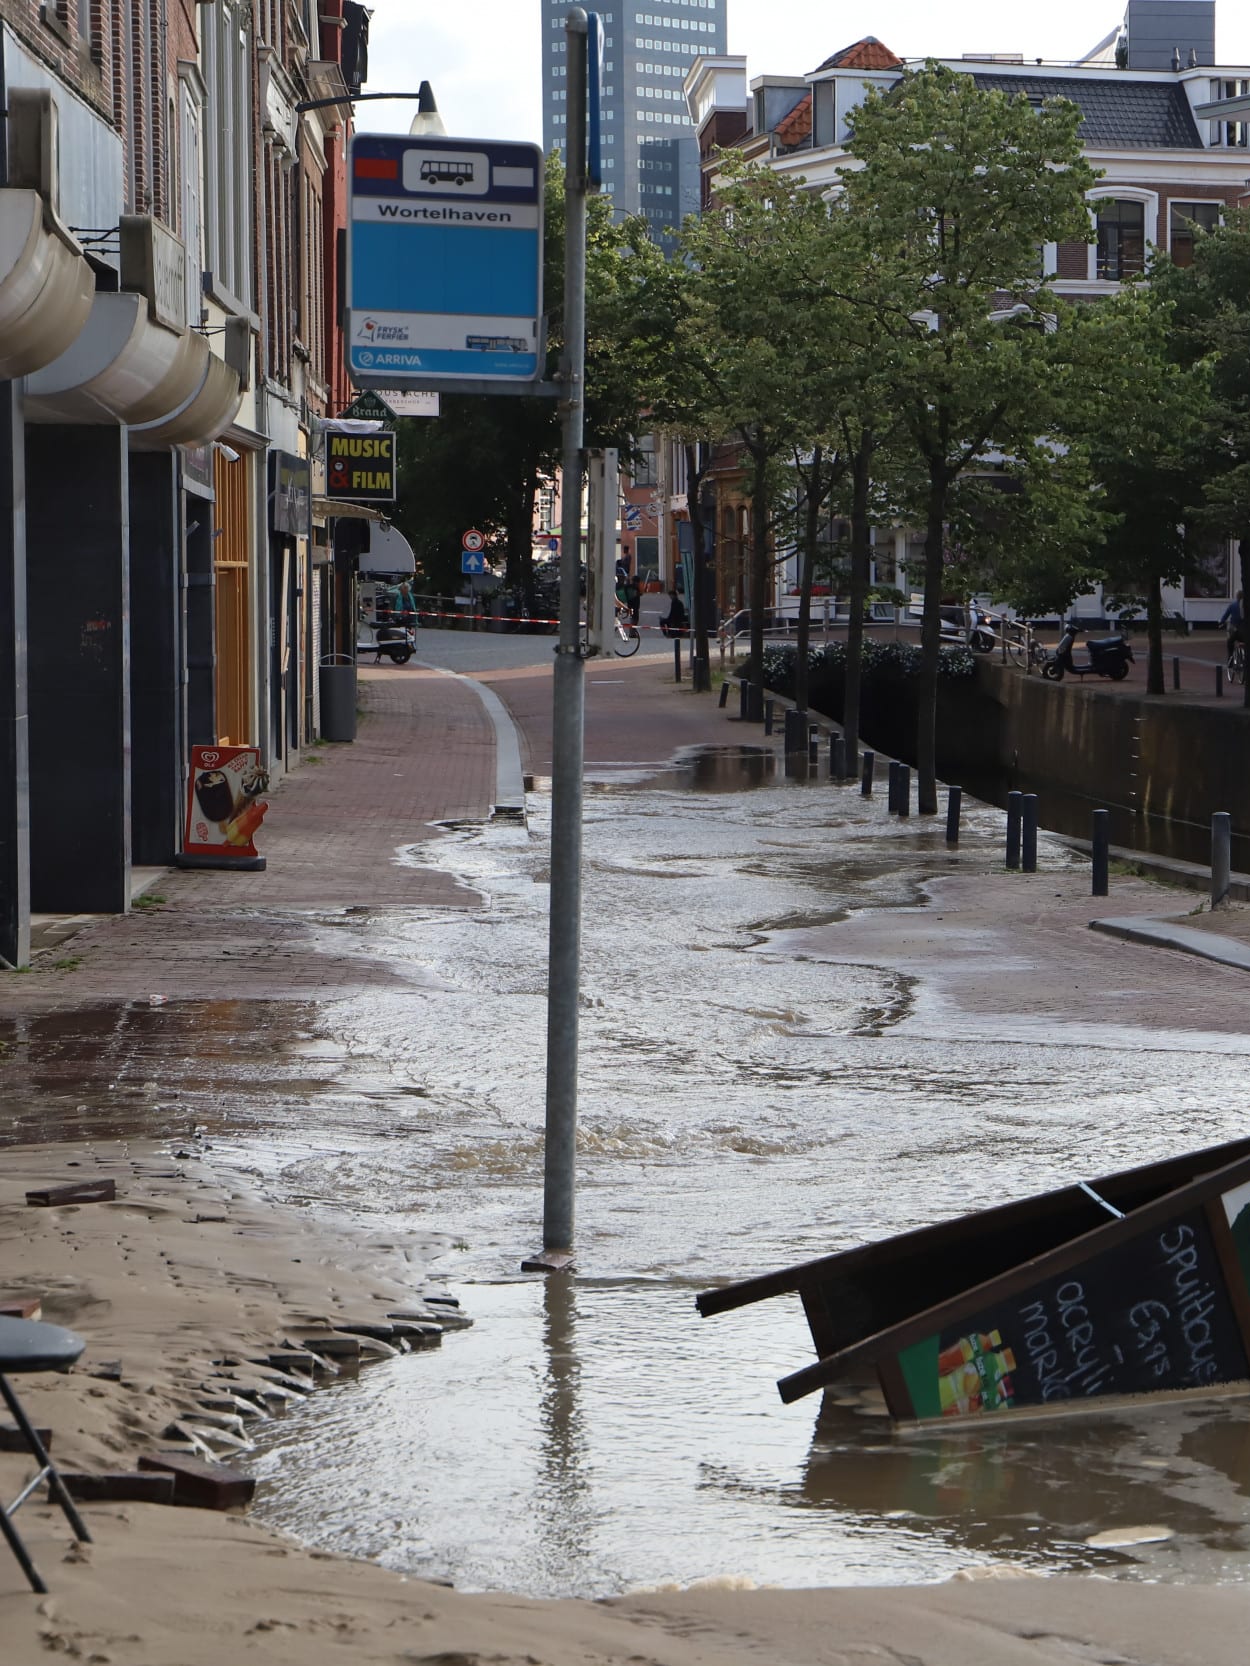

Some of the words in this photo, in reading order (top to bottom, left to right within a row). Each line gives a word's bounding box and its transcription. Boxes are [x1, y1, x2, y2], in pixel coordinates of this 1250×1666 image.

[378, 204, 512, 222] Wortelhaven
[376, 354, 422, 366] ARRIVA
[352, 406, 388, 418] Brand
[331, 437, 391, 458] MUSIC
[329, 456, 349, 488] &
[352, 471, 391, 490] FILM
